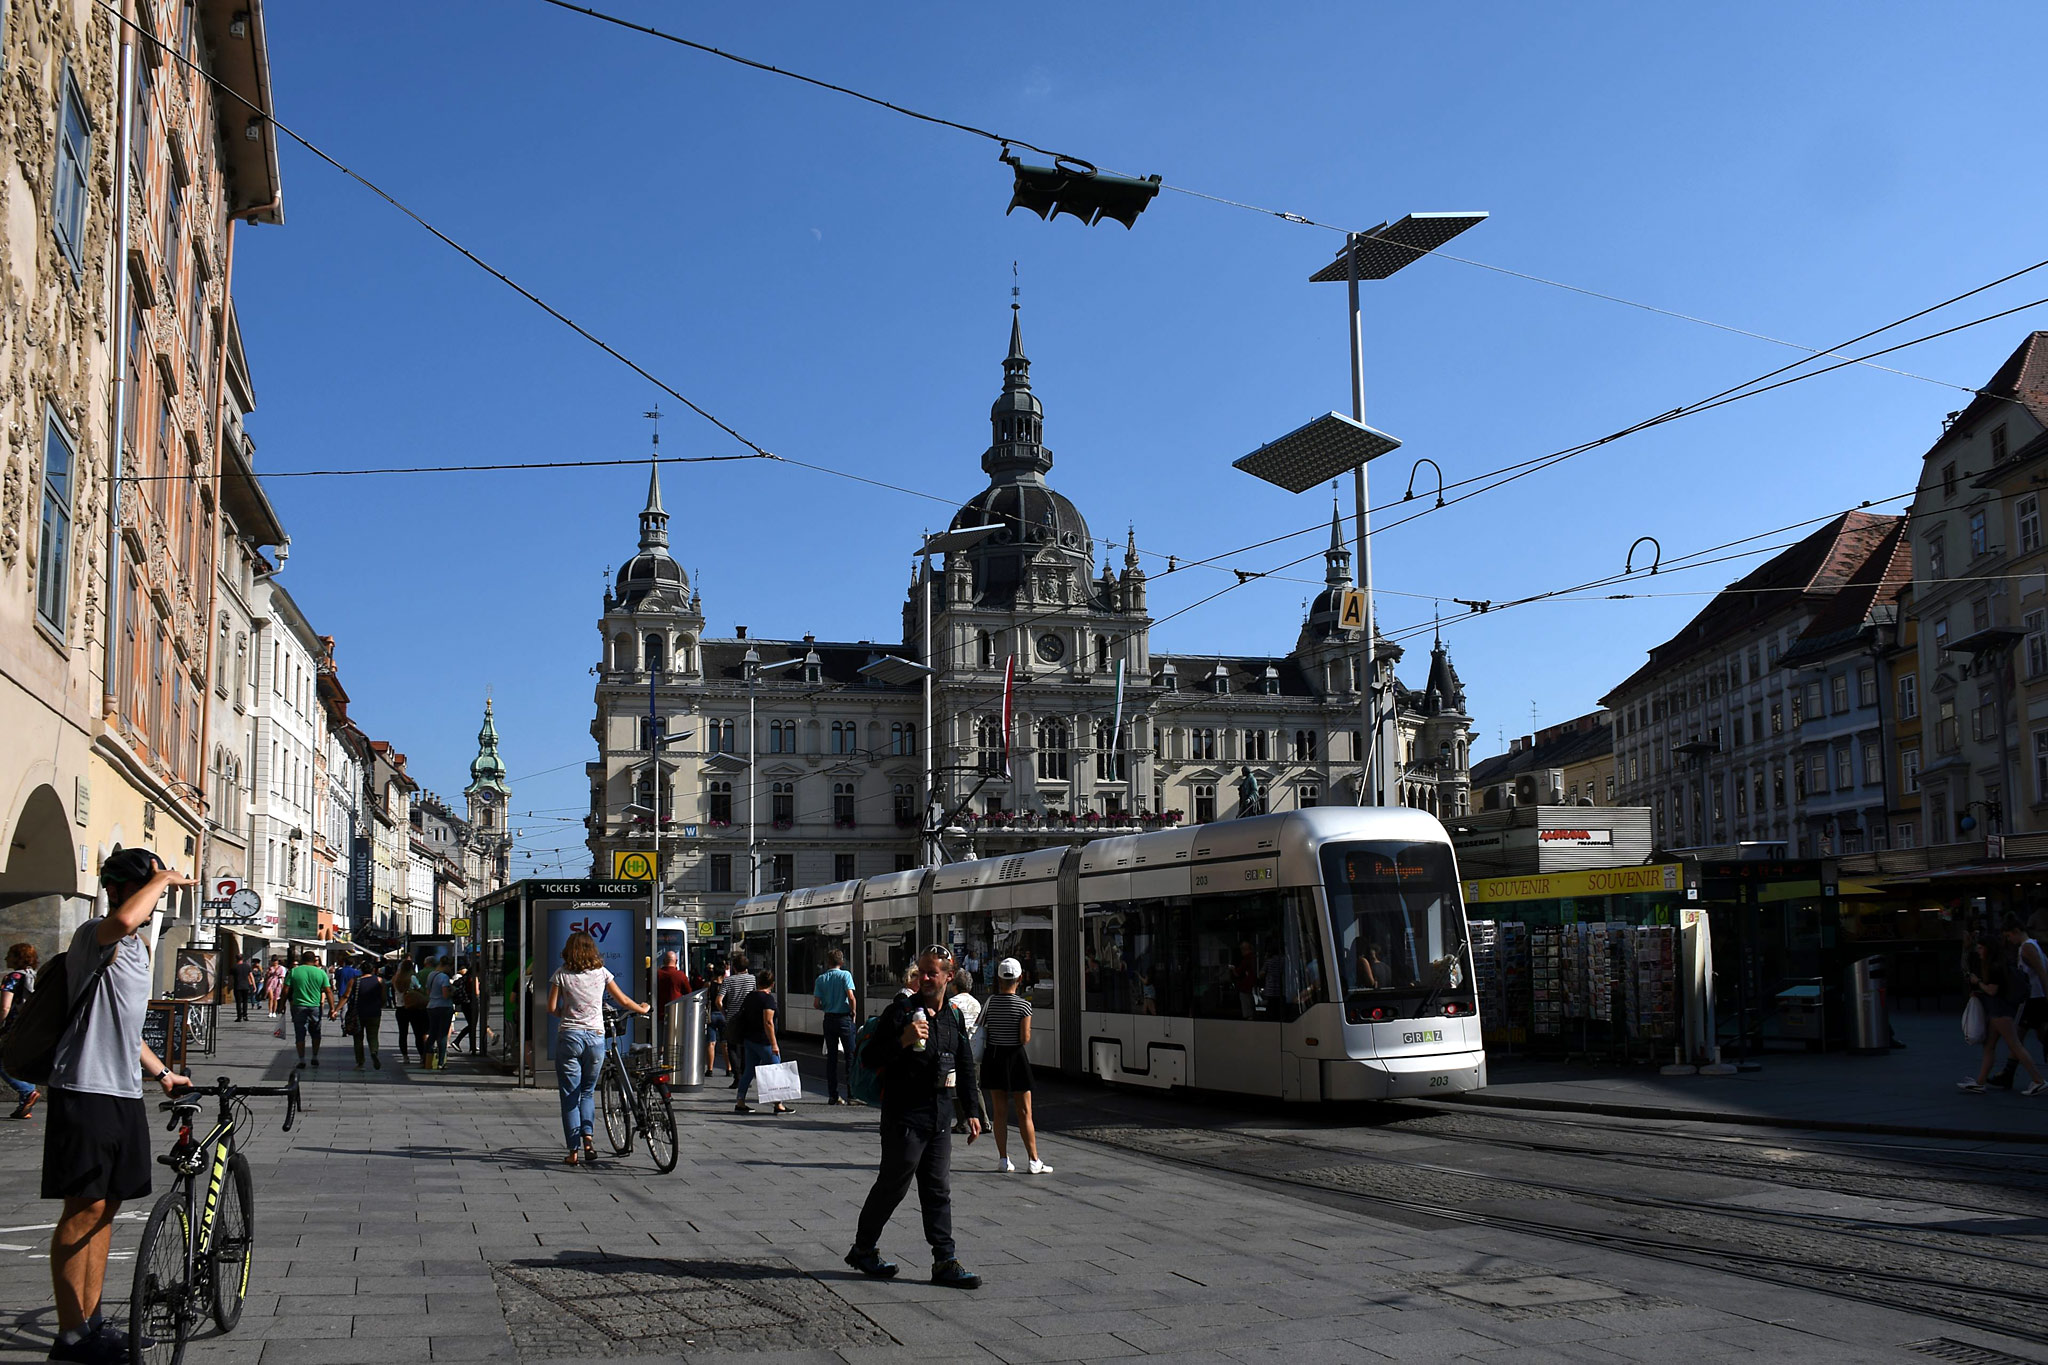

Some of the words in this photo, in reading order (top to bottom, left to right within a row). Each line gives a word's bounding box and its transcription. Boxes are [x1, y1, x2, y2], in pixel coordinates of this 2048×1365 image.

[1344, 595, 1360, 623] A
[357, 852, 367, 900] HUMANIC
[1196, 875, 1208, 885] 203
[1245, 868, 1271, 880] GRAZ
[1588, 870, 1660, 890] SOUVENIR
[541, 884, 581, 893] TICKETS
[598, 884, 638, 893] TICKETS
[1489, 879, 1550, 897] SOUVENIR
[569, 917, 612, 942] sky
[1403, 1030, 1442, 1044] GRAZ
[1429, 1075, 1449, 1087] 203
